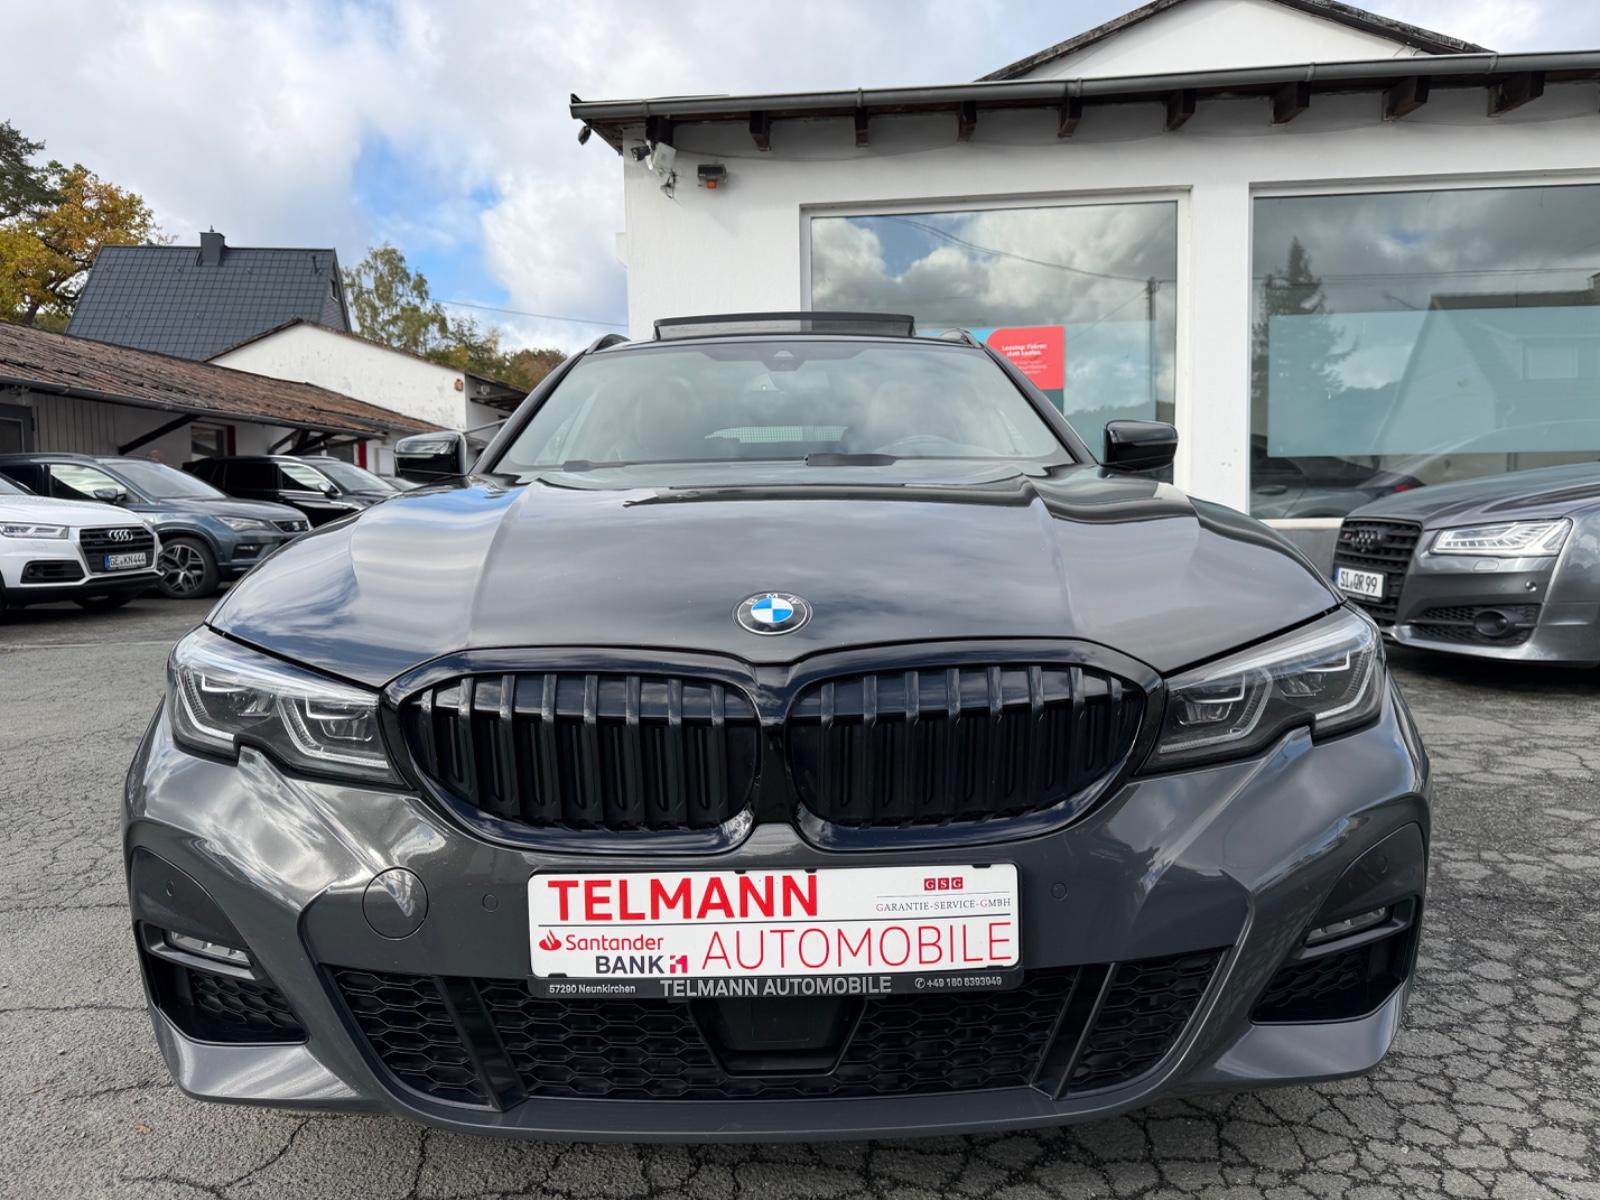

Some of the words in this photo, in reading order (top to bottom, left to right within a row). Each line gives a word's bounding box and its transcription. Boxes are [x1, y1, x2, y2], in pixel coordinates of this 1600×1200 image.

[1366, 576, 1377, 593] 99
[924, 877, 963, 891] GSG
[548, 875, 818, 921] TELMANN
[876, 898, 1011, 912] GARANTIE-SERVICE-GMBH
[566, 934, 664, 951] Santander
[702, 922, 1012, 970] AUTOMOBILE
[578, 984, 636, 993] Neunkirchen
[660, 979, 759, 997] TELMANN
[763, 976, 892, 996] AUTOMOBILE
[926, 978, 944, 988] +49
